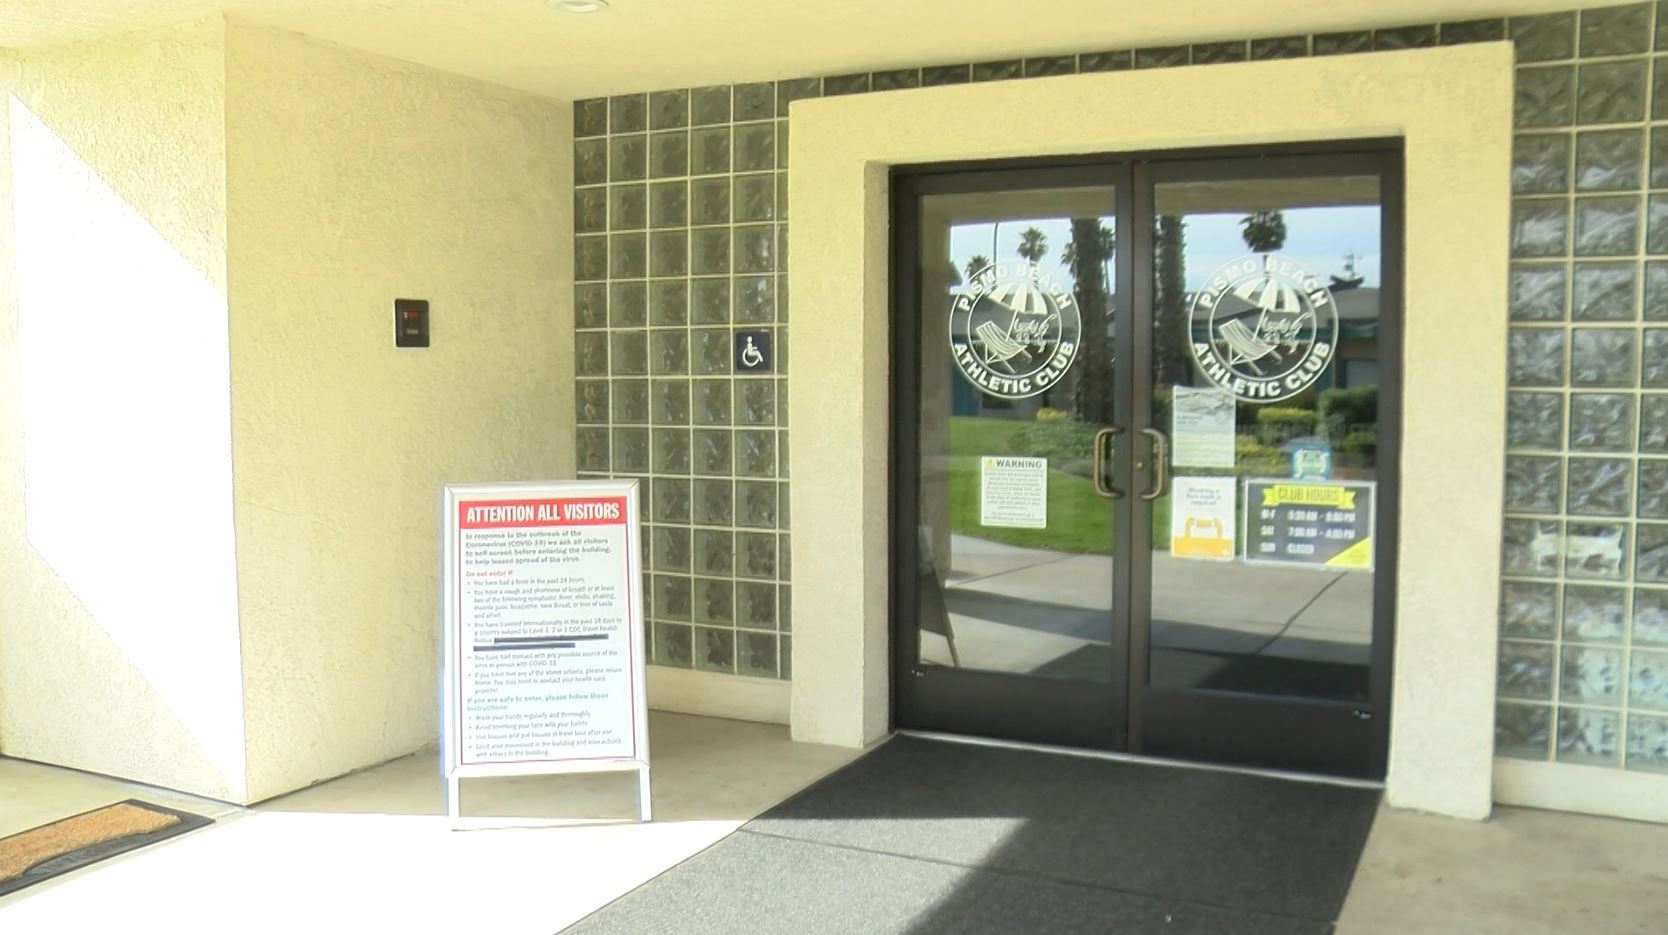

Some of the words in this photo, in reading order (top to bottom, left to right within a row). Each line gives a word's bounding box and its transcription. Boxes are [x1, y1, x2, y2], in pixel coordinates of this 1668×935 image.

[1199, 260, 1257, 308] PISMO
[1266, 257, 1328, 308] BEACH
[954, 343, 1032, 394] ATHLETIC
[1036, 342, 1074, 386] CLUB
[1194, 343, 1282, 397] ATHLETIC
[1286, 342, 1330, 389] CLUB
[996, 459, 1042, 469] WARNING
[1278, 487, 1304, 500] CLUB
[1306, 488, 1339, 501] HOURS
[466, 505, 534, 523] ATTENTION
[538, 504, 560, 520] ALL
[564, 502, 620, 520] VISITORS
[1287, 543, 1315, 554] CLOSED
